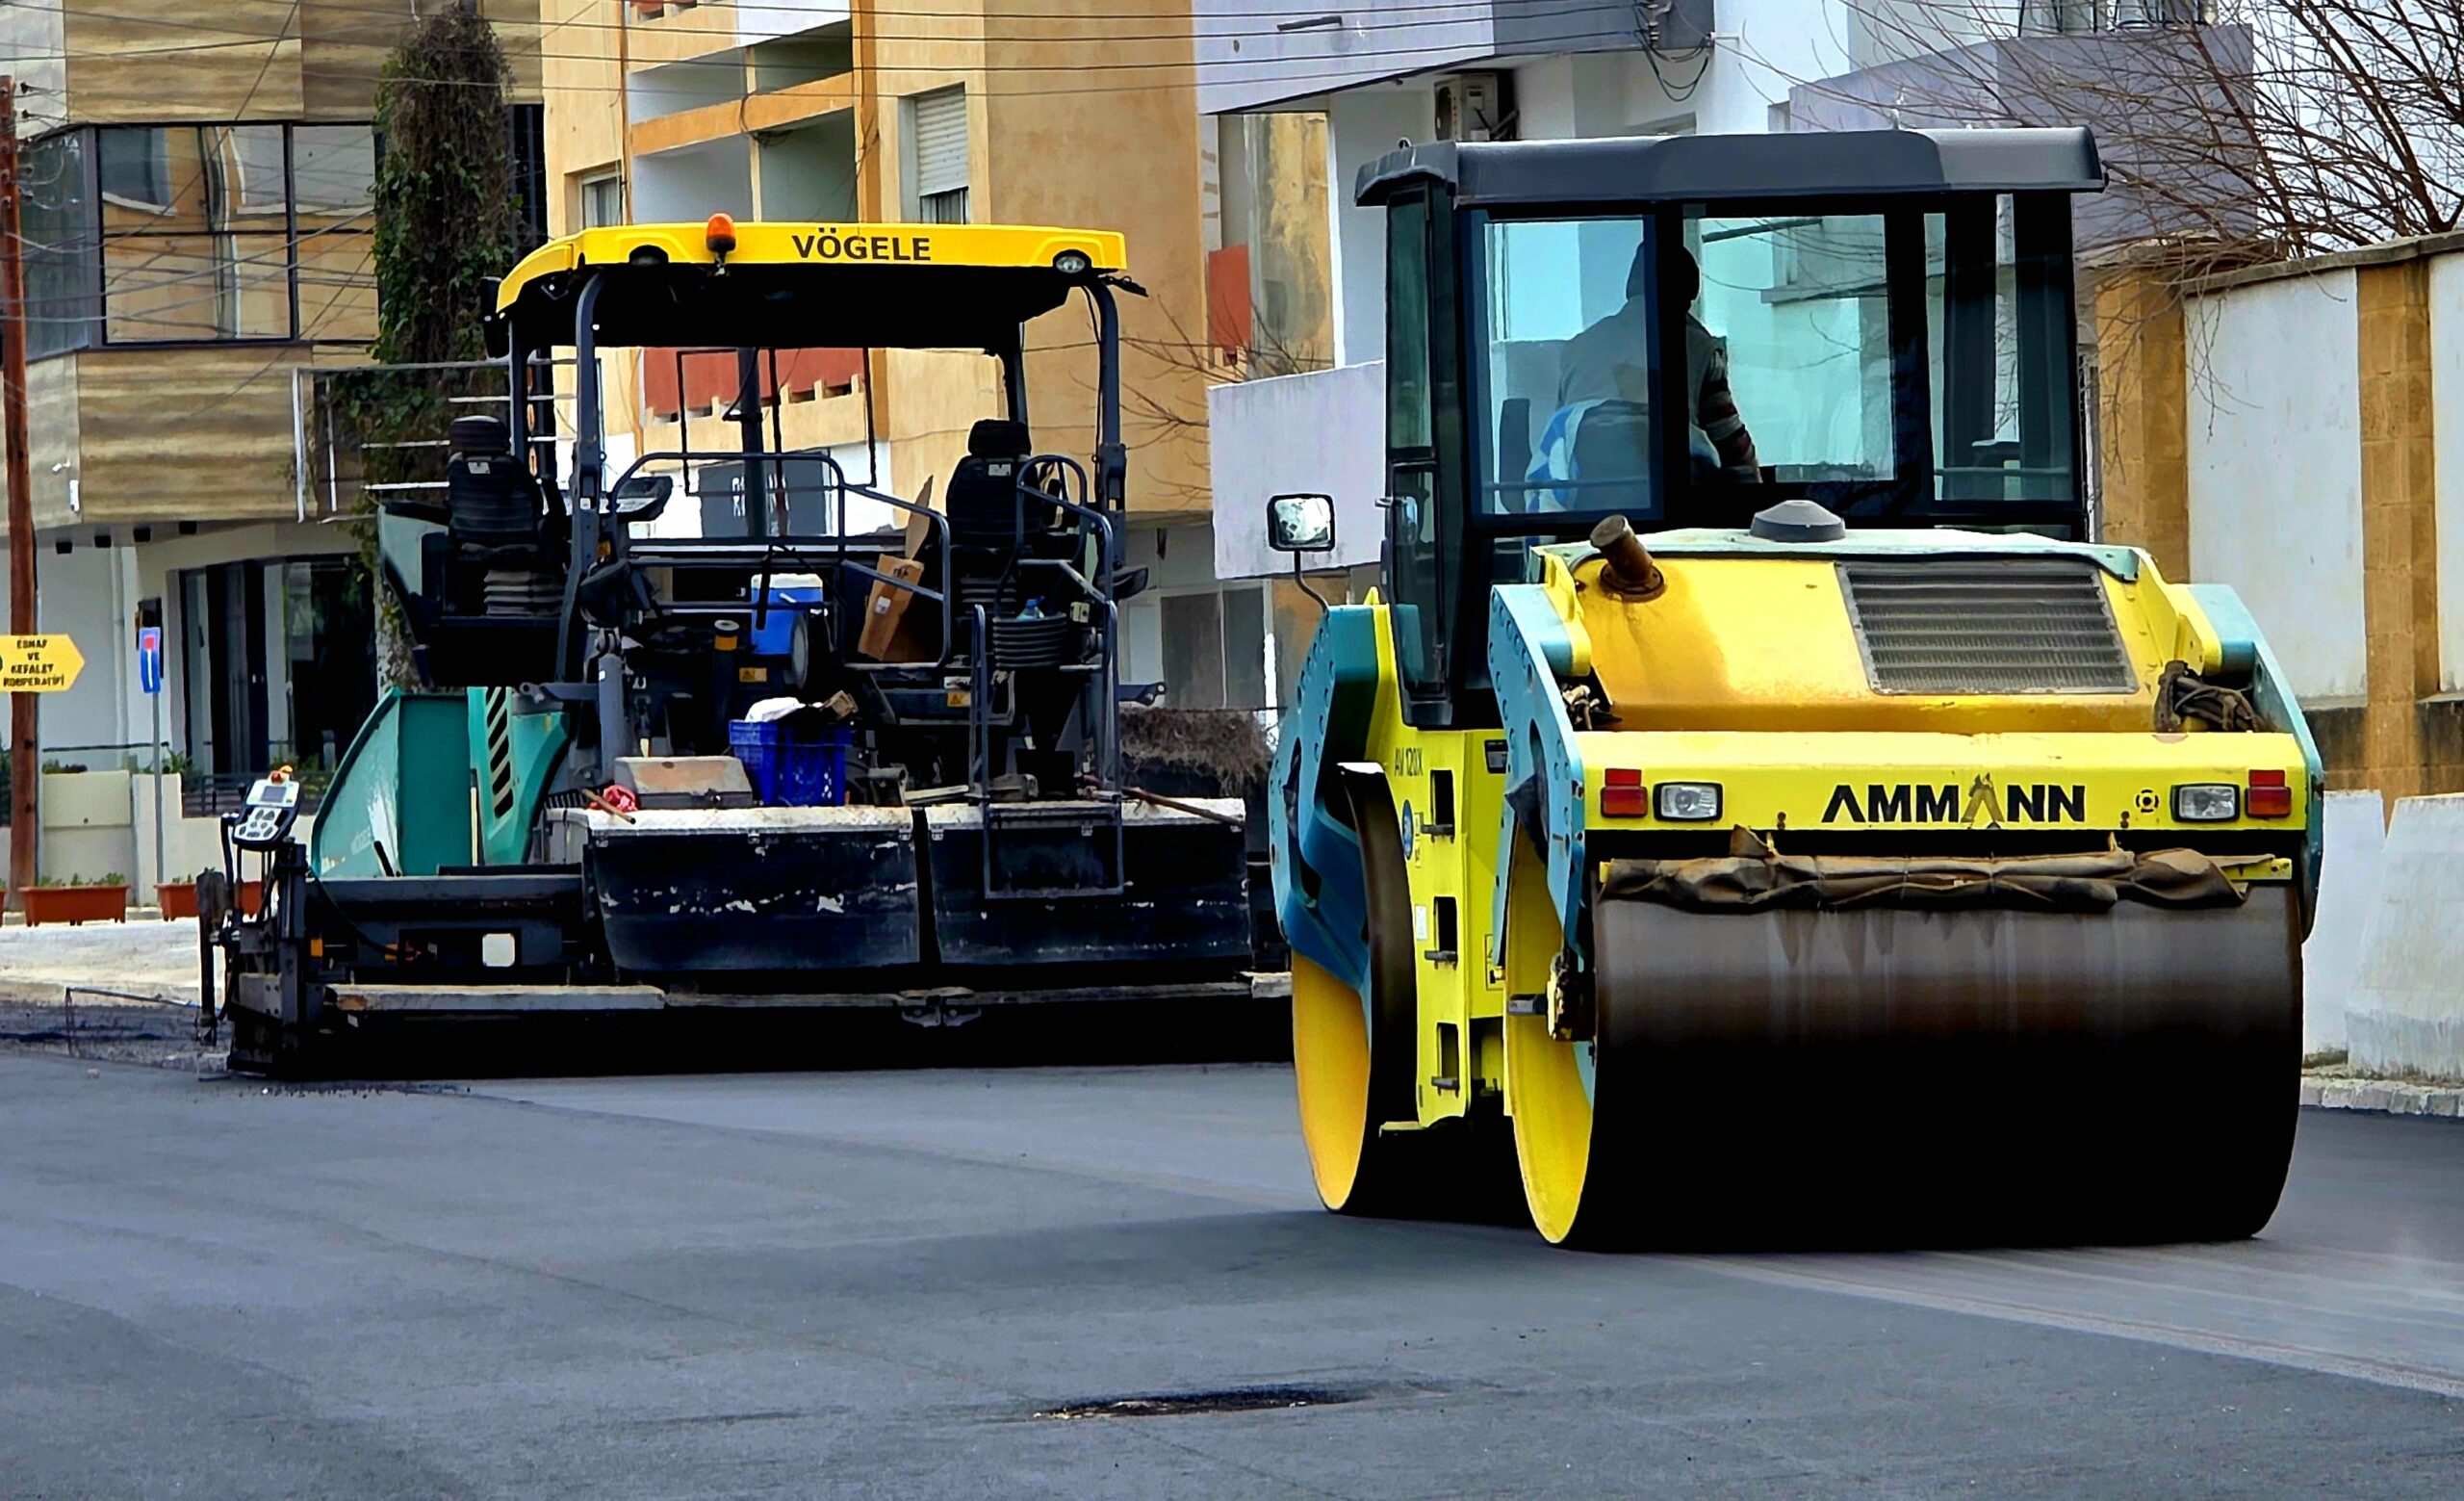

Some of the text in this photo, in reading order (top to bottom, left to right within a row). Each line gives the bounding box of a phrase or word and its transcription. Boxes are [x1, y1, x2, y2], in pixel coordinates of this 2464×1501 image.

[792, 227, 931, 261] VÖGELE
[27, 652, 39, 660] VE
[1821, 775, 2086, 823] AMMANN
